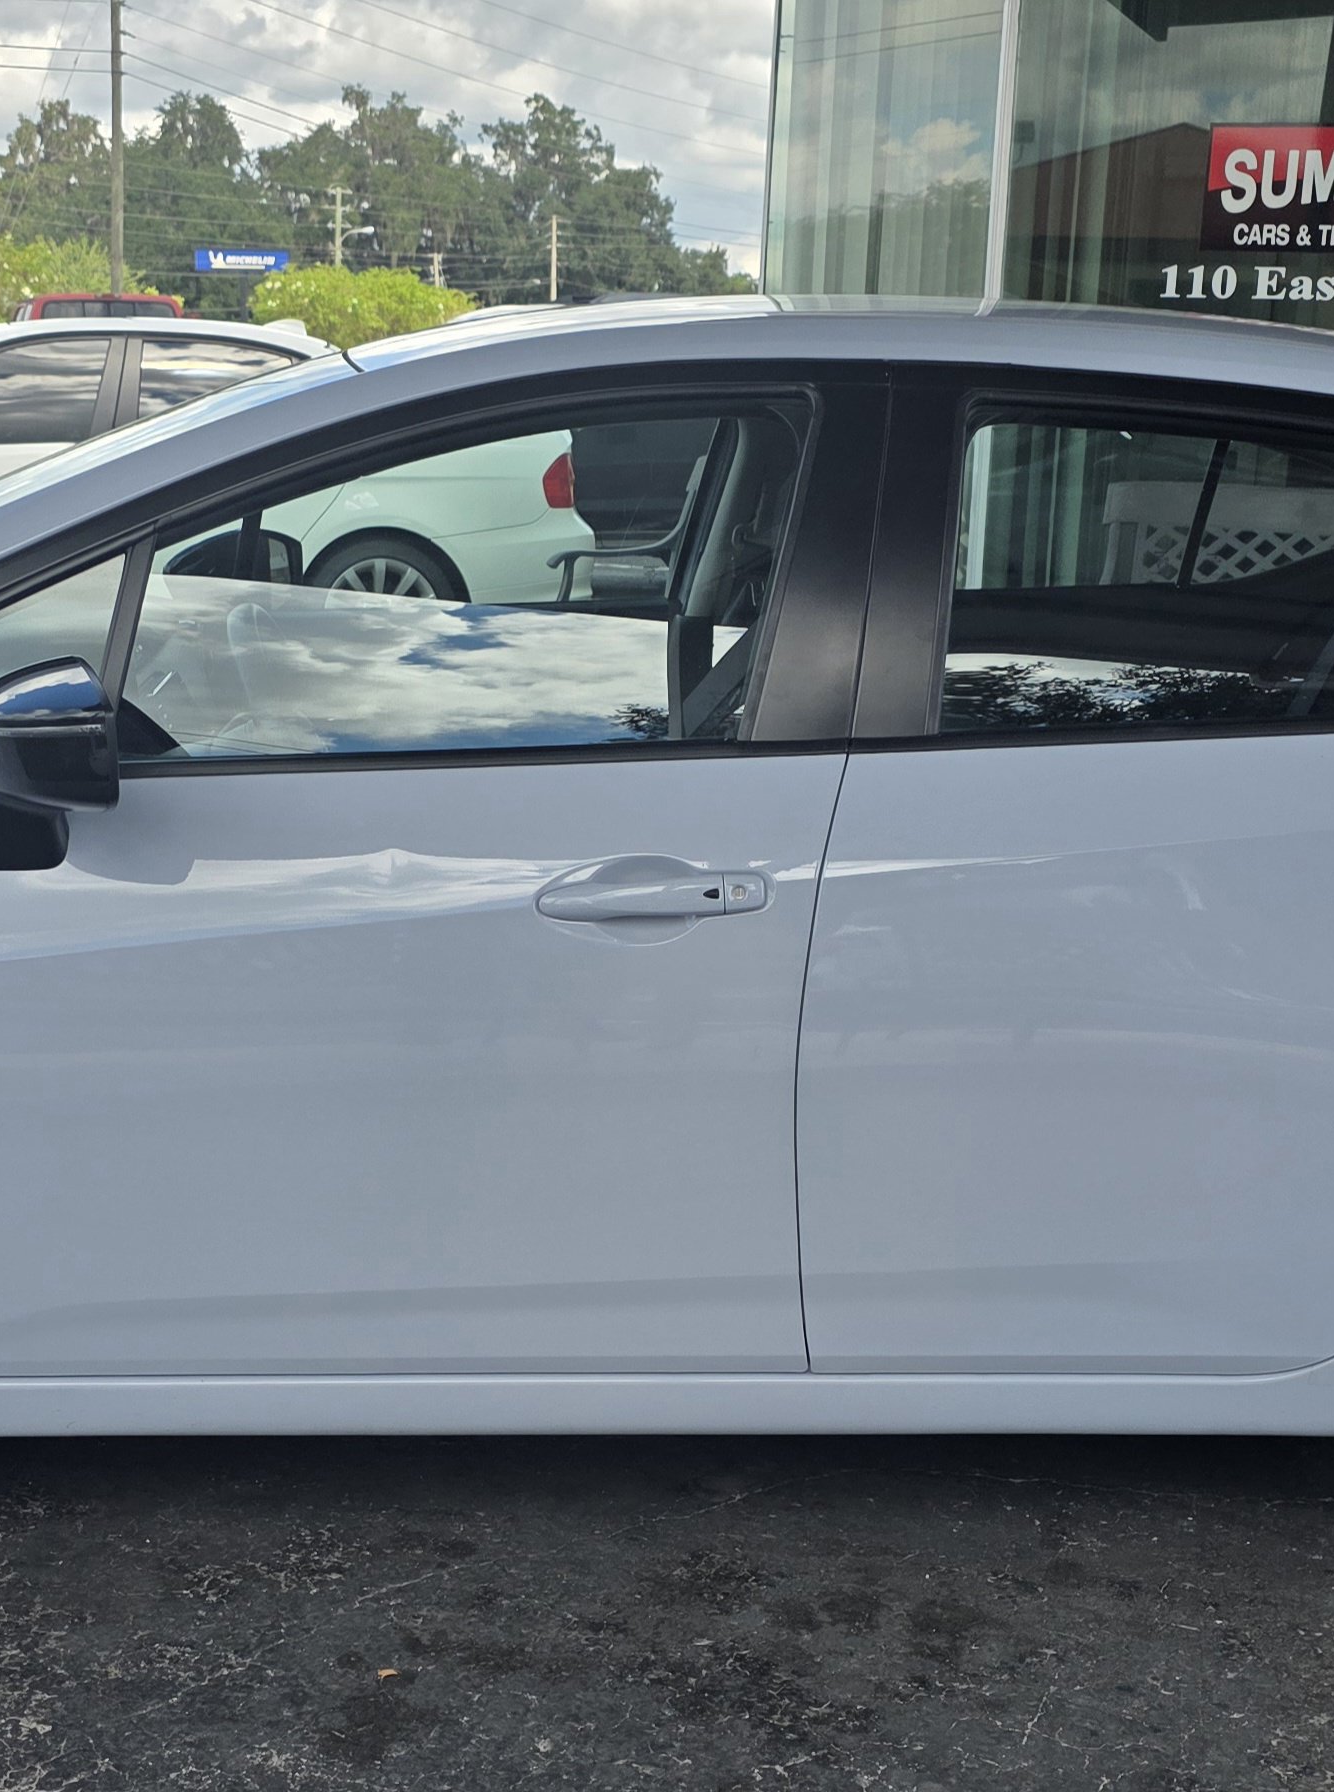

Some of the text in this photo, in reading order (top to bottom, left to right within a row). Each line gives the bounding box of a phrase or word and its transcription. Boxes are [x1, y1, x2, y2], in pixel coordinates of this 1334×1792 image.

[1233, 223, 1290, 246] CARS
[1296, 224, 1312, 246] &
[225, 255, 275, 265] MICHELIN
[1160, 264, 1237, 299] 110
